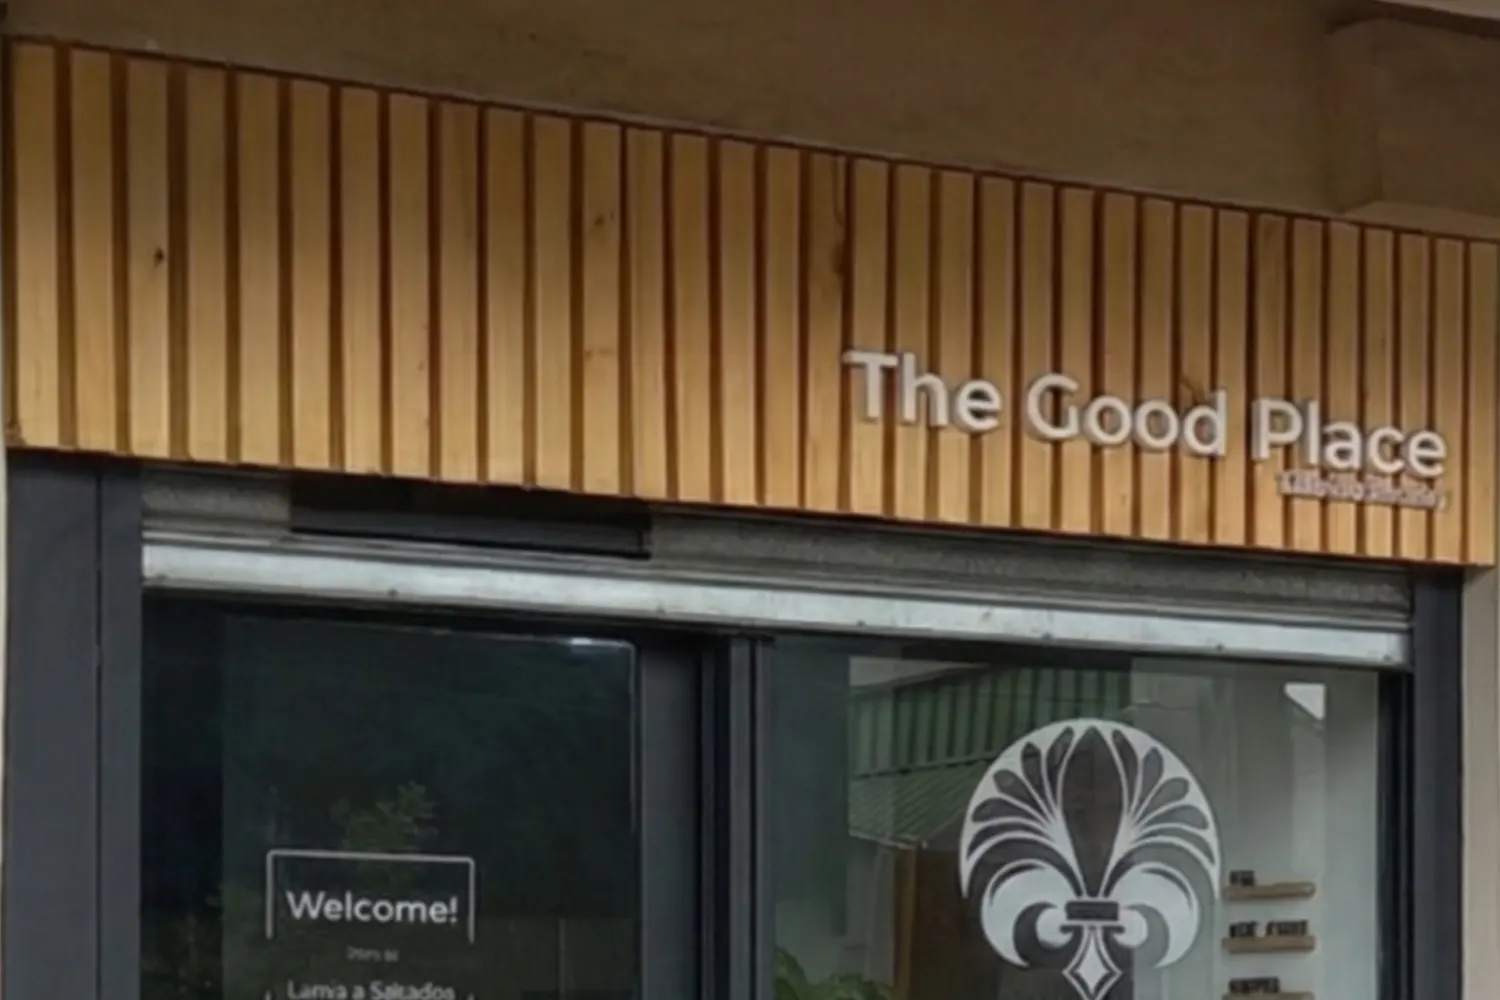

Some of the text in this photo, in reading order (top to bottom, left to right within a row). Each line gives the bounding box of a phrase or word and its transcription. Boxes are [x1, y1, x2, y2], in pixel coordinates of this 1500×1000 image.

[842, 349, 1447, 477] The Good Place
[286, 890, 458, 924] Welcome!
